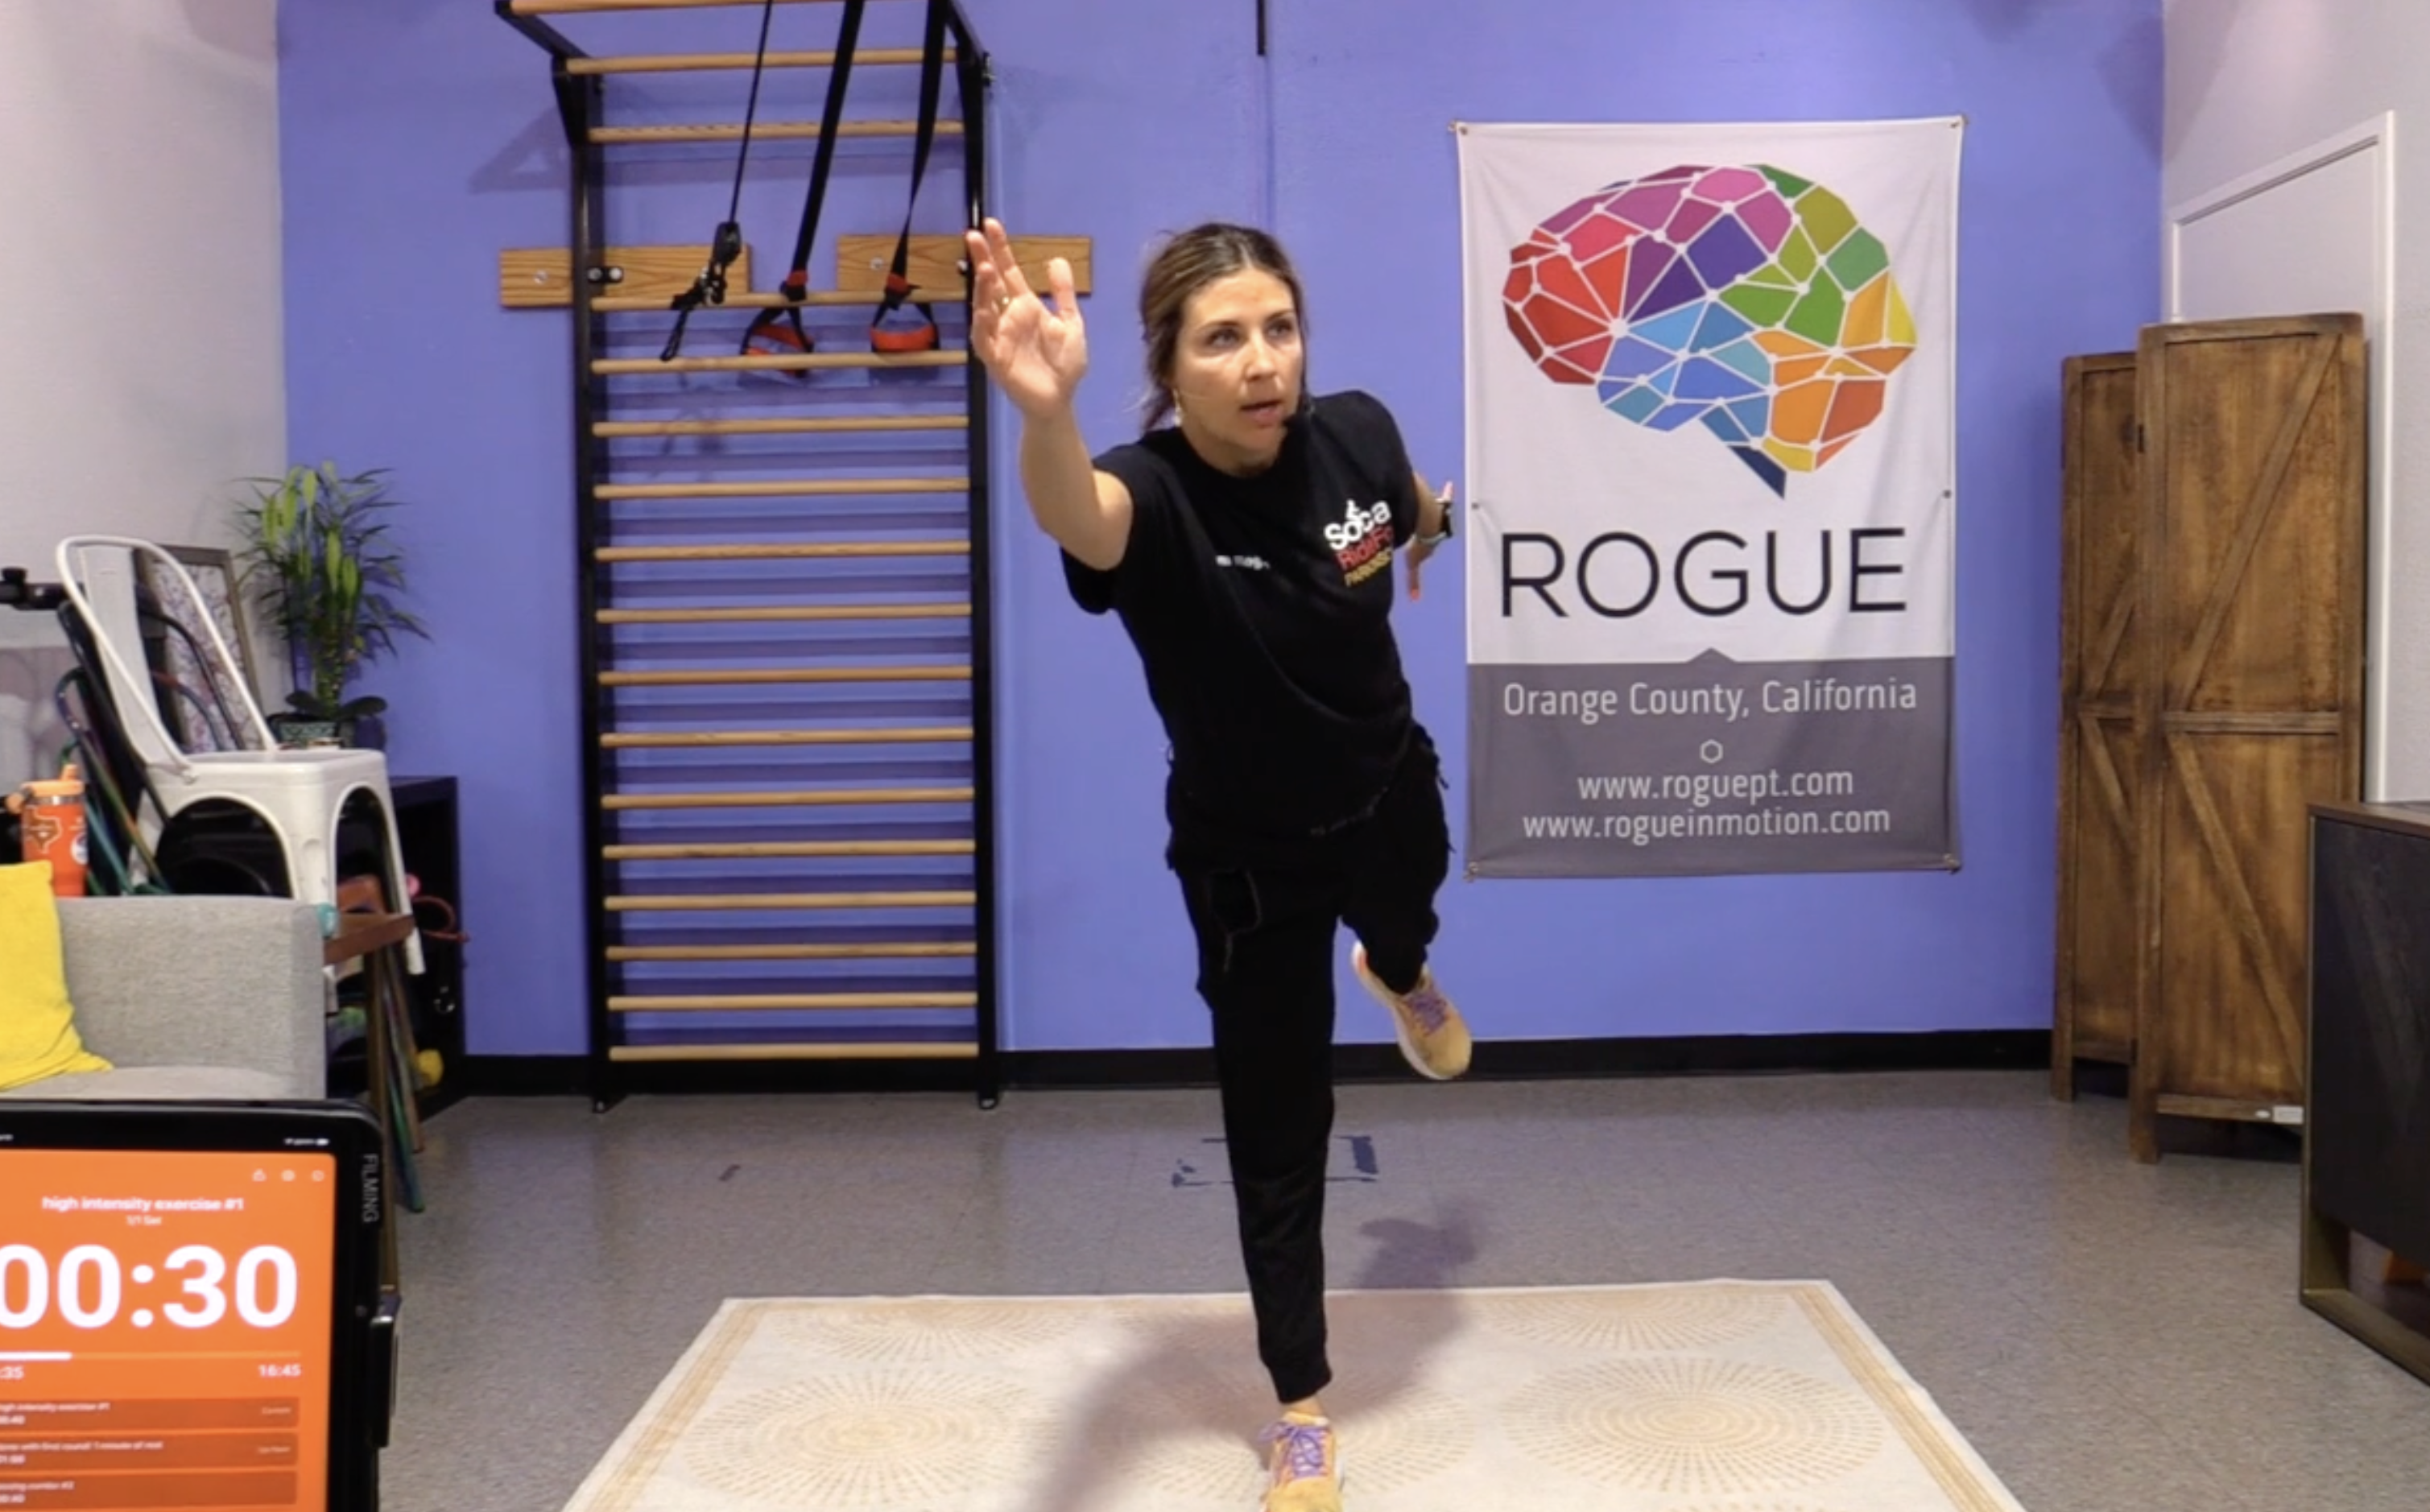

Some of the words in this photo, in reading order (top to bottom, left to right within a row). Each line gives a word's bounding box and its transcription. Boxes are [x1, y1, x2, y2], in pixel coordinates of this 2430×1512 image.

[1502, 527, 1906, 618] ROGUE
[1503, 683, 1618, 725] Orange
[1630, 682, 1750, 722] County,
[1762, 677, 1917, 713] California
[1577, 769, 1853, 807] www.roguept.com
[1523, 808, 1891, 845] www.rogueinmotion.com
[42, 1196, 79, 1212] high
[82, 1196, 151, 1212] intensity
[154, 1197, 221, 1211] exercise
[224, 1197, 244, 1211] #1
[0, 1244, 297, 1328] 00:30
[258, 1363, 302, 1378] 16:45
